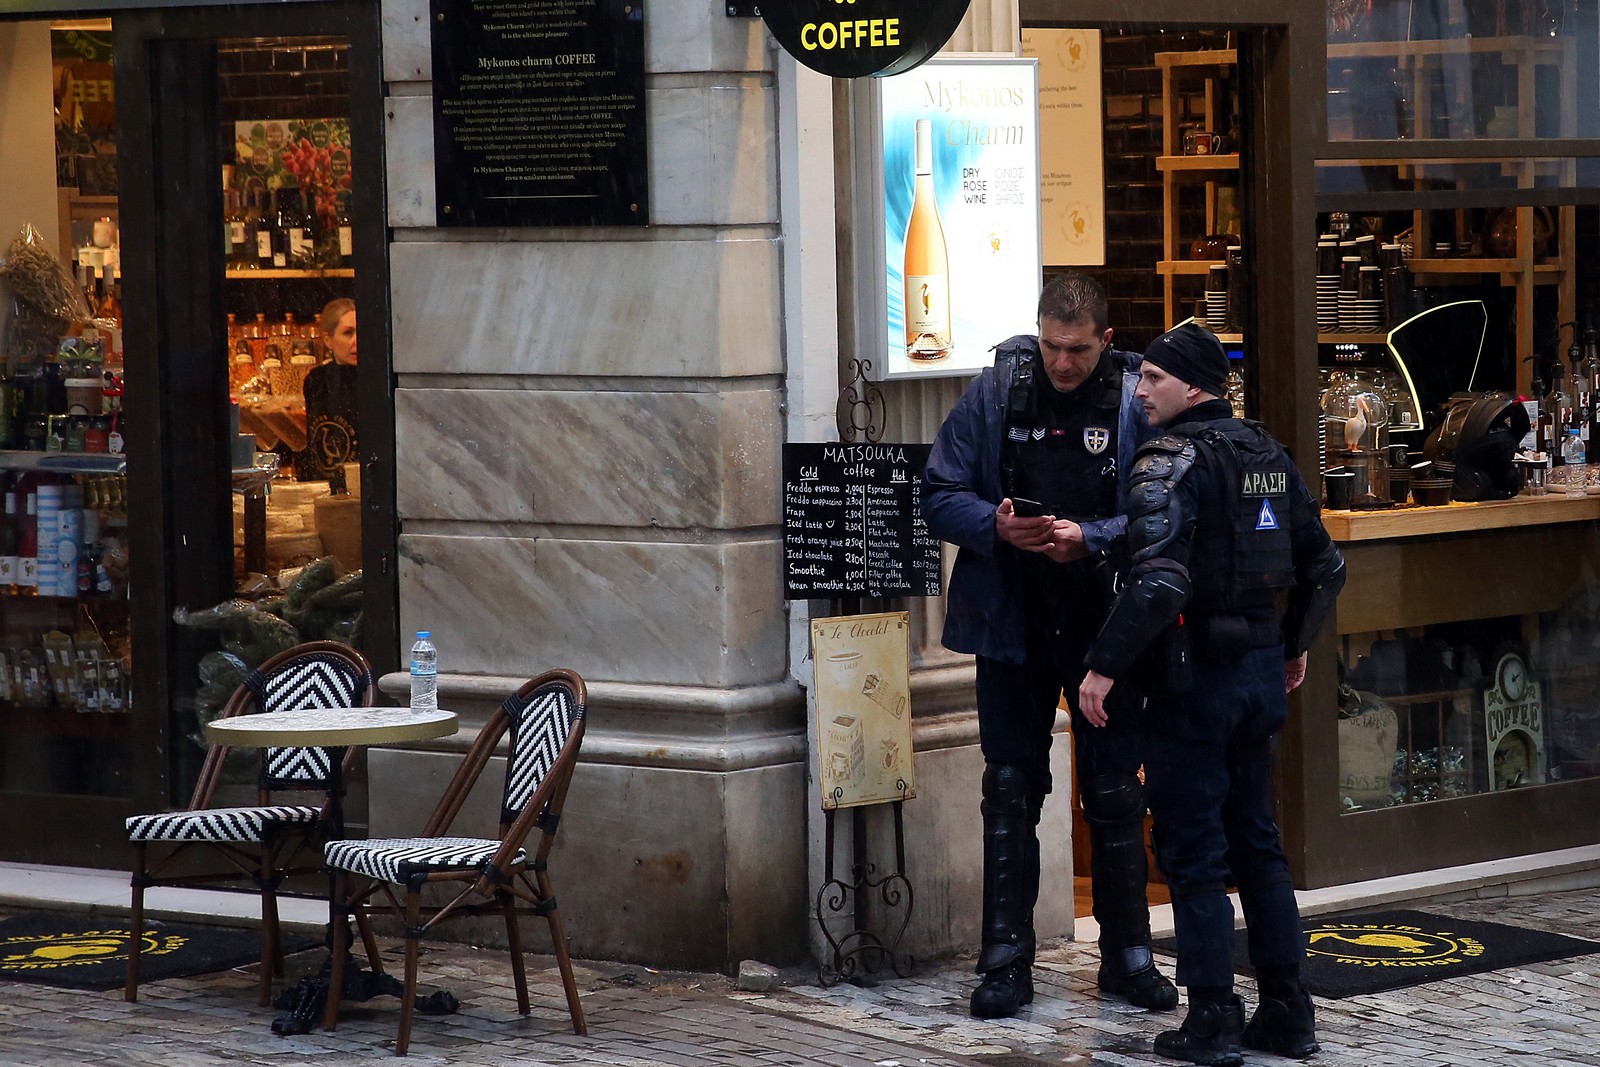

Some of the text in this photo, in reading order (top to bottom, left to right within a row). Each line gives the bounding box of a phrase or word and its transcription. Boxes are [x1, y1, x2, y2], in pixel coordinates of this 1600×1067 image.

[482, 22, 506, 31] Mykonos
[801, 18, 900, 50] COFFEE
[478, 54, 596, 69] Mykonos charm COFFEE
[924, 80, 1024, 112] Mykonos
[947, 119, 1024, 146] Charm
[963, 168, 980, 178] DRY
[963, 181, 987, 191] ROSE
[964, 194, 986, 204] WINE
[823, 445, 908, 464] MATSOUKA
[800, 466, 818, 478] Cold
[843, 463, 876, 478] coffee
[892, 468, 906, 481] Hot
[786, 482, 812, 493] Freddo
[814, 485, 840, 493] espresso
[1242, 471, 1286, 494] ΔΡΑΣΗ
[867, 484, 894, 495] Espresso
[786, 494, 810, 504] Freddo
[867, 498, 898, 506] Americano
[786, 506, 805, 517] Frape
[786, 519, 802, 528] Iced
[868, 518, 886, 527] Latte
[868, 528, 882, 536] Flat
[883, 528, 897, 537] white
[787, 534, 805, 544] Fresh
[807, 538, 828, 548] orange
[830, 537, 843, 548] juice
[787, 549, 803, 559] Iced
[805, 550, 833, 561] chocolate
[789, 562, 826, 576] Smoothie
[868, 558, 884, 568] Greek
[886, 559, 903, 569] coffee
[886, 569, 902, 579] coffee
[813, 579, 844, 590] smoothie
[883, 579, 912, 589] chocolate
[1488, 702, 1540, 742] COFFEE
[1336, 958, 1462, 967] mykonos
